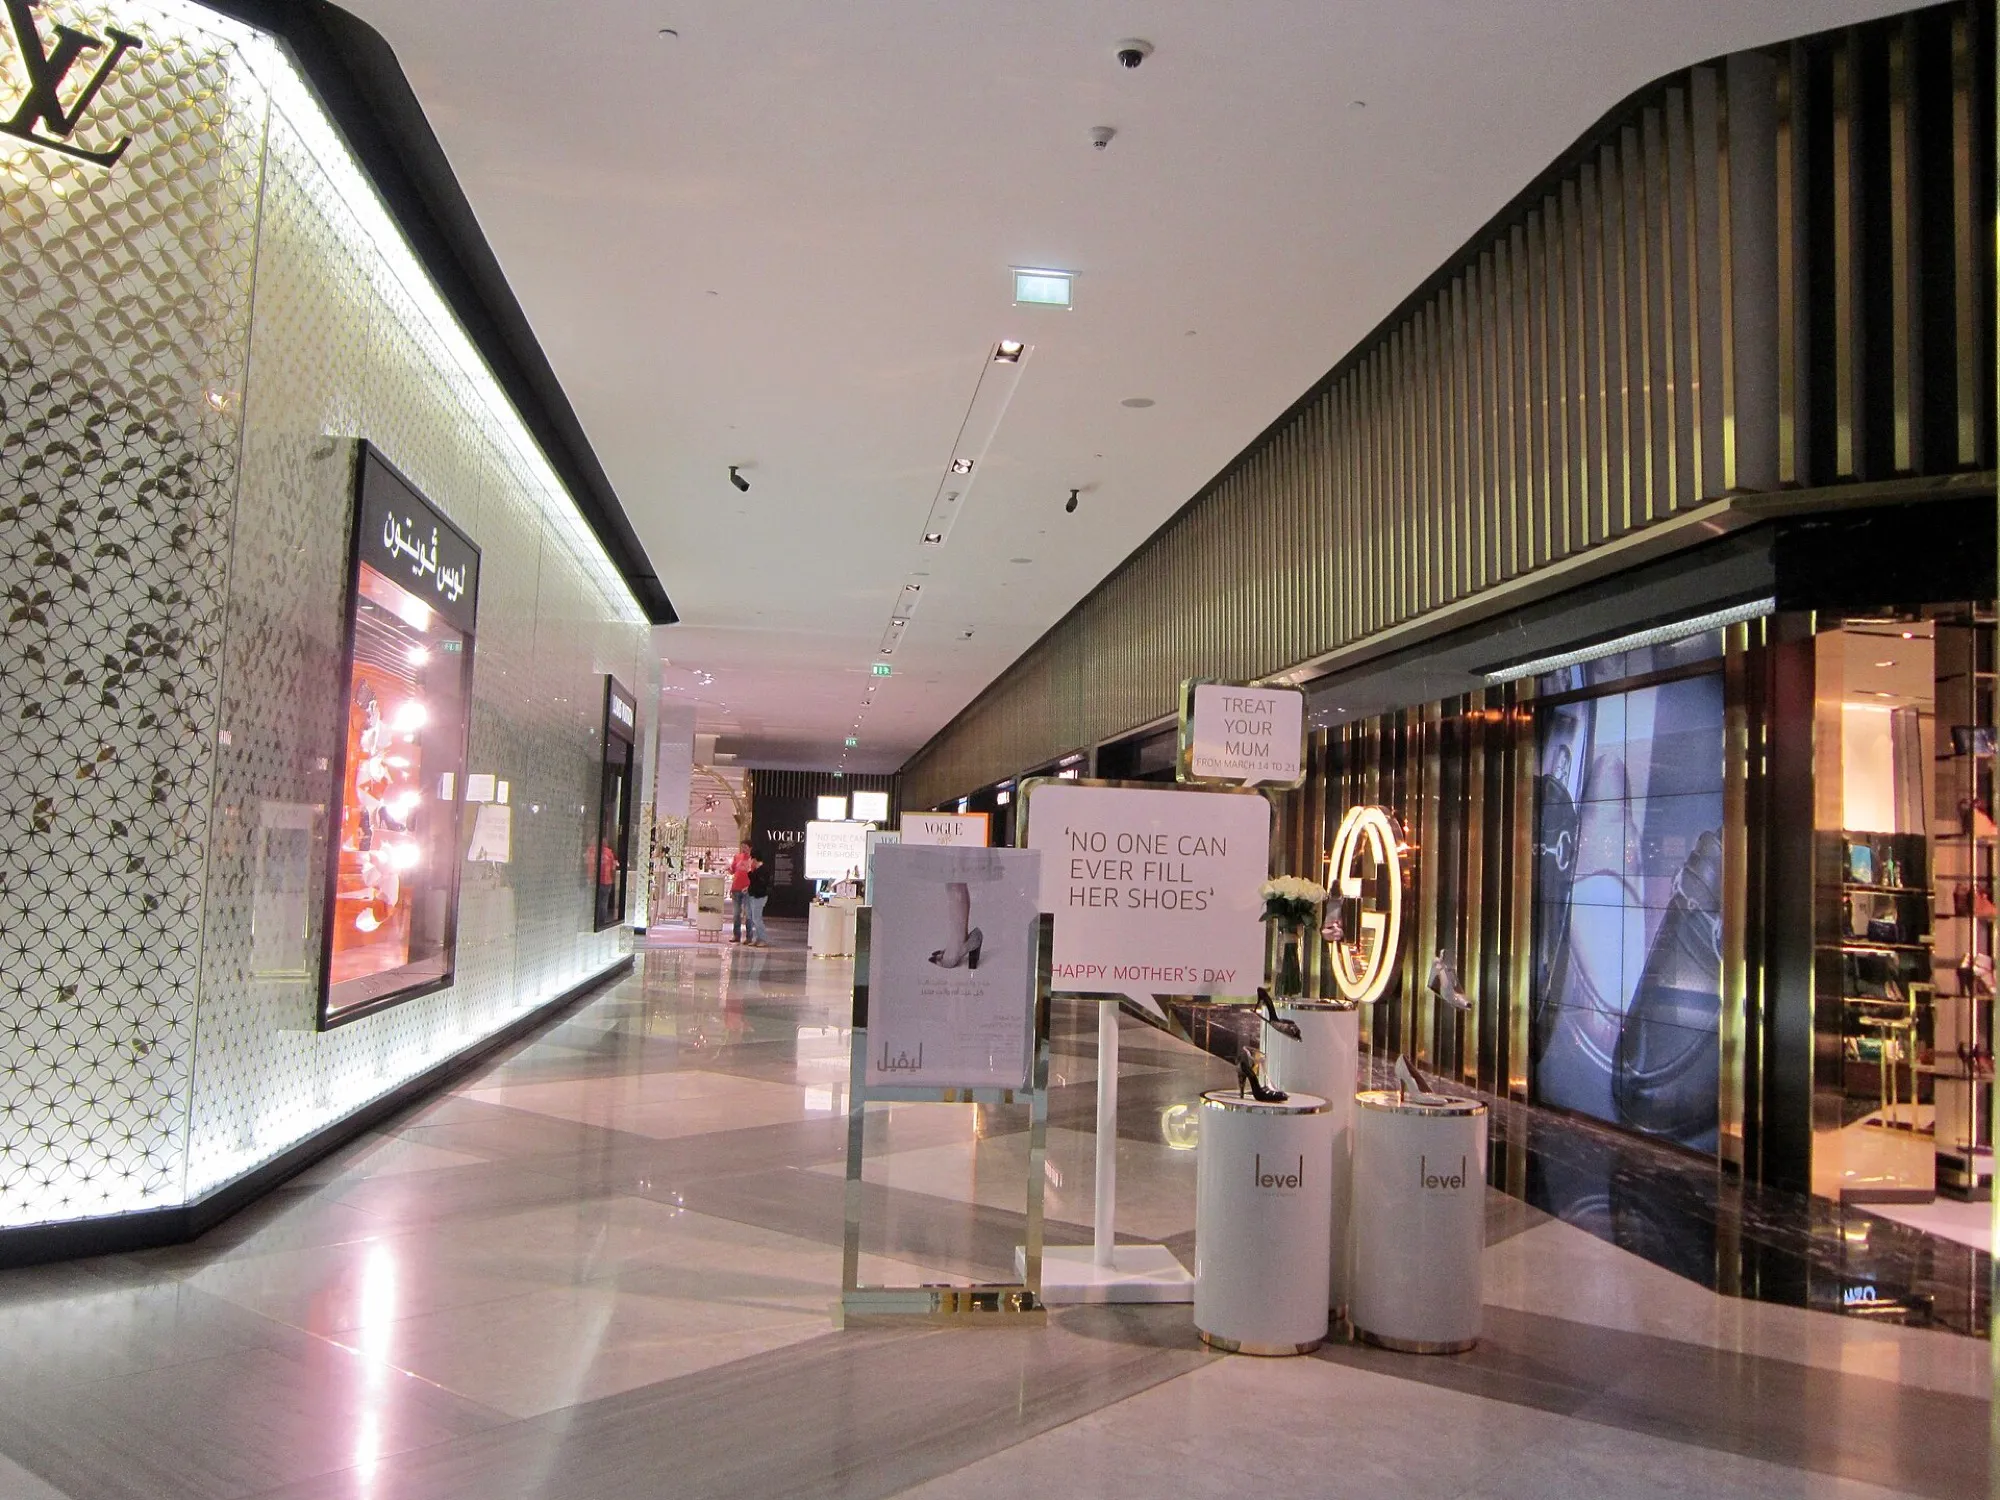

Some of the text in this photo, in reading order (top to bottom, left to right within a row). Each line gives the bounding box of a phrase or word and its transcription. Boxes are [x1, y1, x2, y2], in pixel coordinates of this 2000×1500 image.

[436, 563, 466, 602] لويس
[1221, 696, 1277, 715] TREAT
[1223, 718, 1272, 736] YOUR
[1225, 740, 1269, 758] MUM
[1196, 757, 1296, 772] FROM MARCH 14 TO 21
[767, 829, 805, 843] VOGUE
[924, 821, 963, 836] VOGUE
[817, 842, 837, 850] EVER
[817, 850, 832, 858] HER
[1117, 832, 1169, 855] ONE
[1178, 835, 1227, 857] CAN
[1070, 858, 1193, 883] EVER FILL
[1069, 886, 1118, 907] HER
[1051, 963, 1236, 983] HAPPY MOTHER'S DAY
[1255, 1153, 1303, 1189] level
[1420, 1155, 1466, 1189] level
